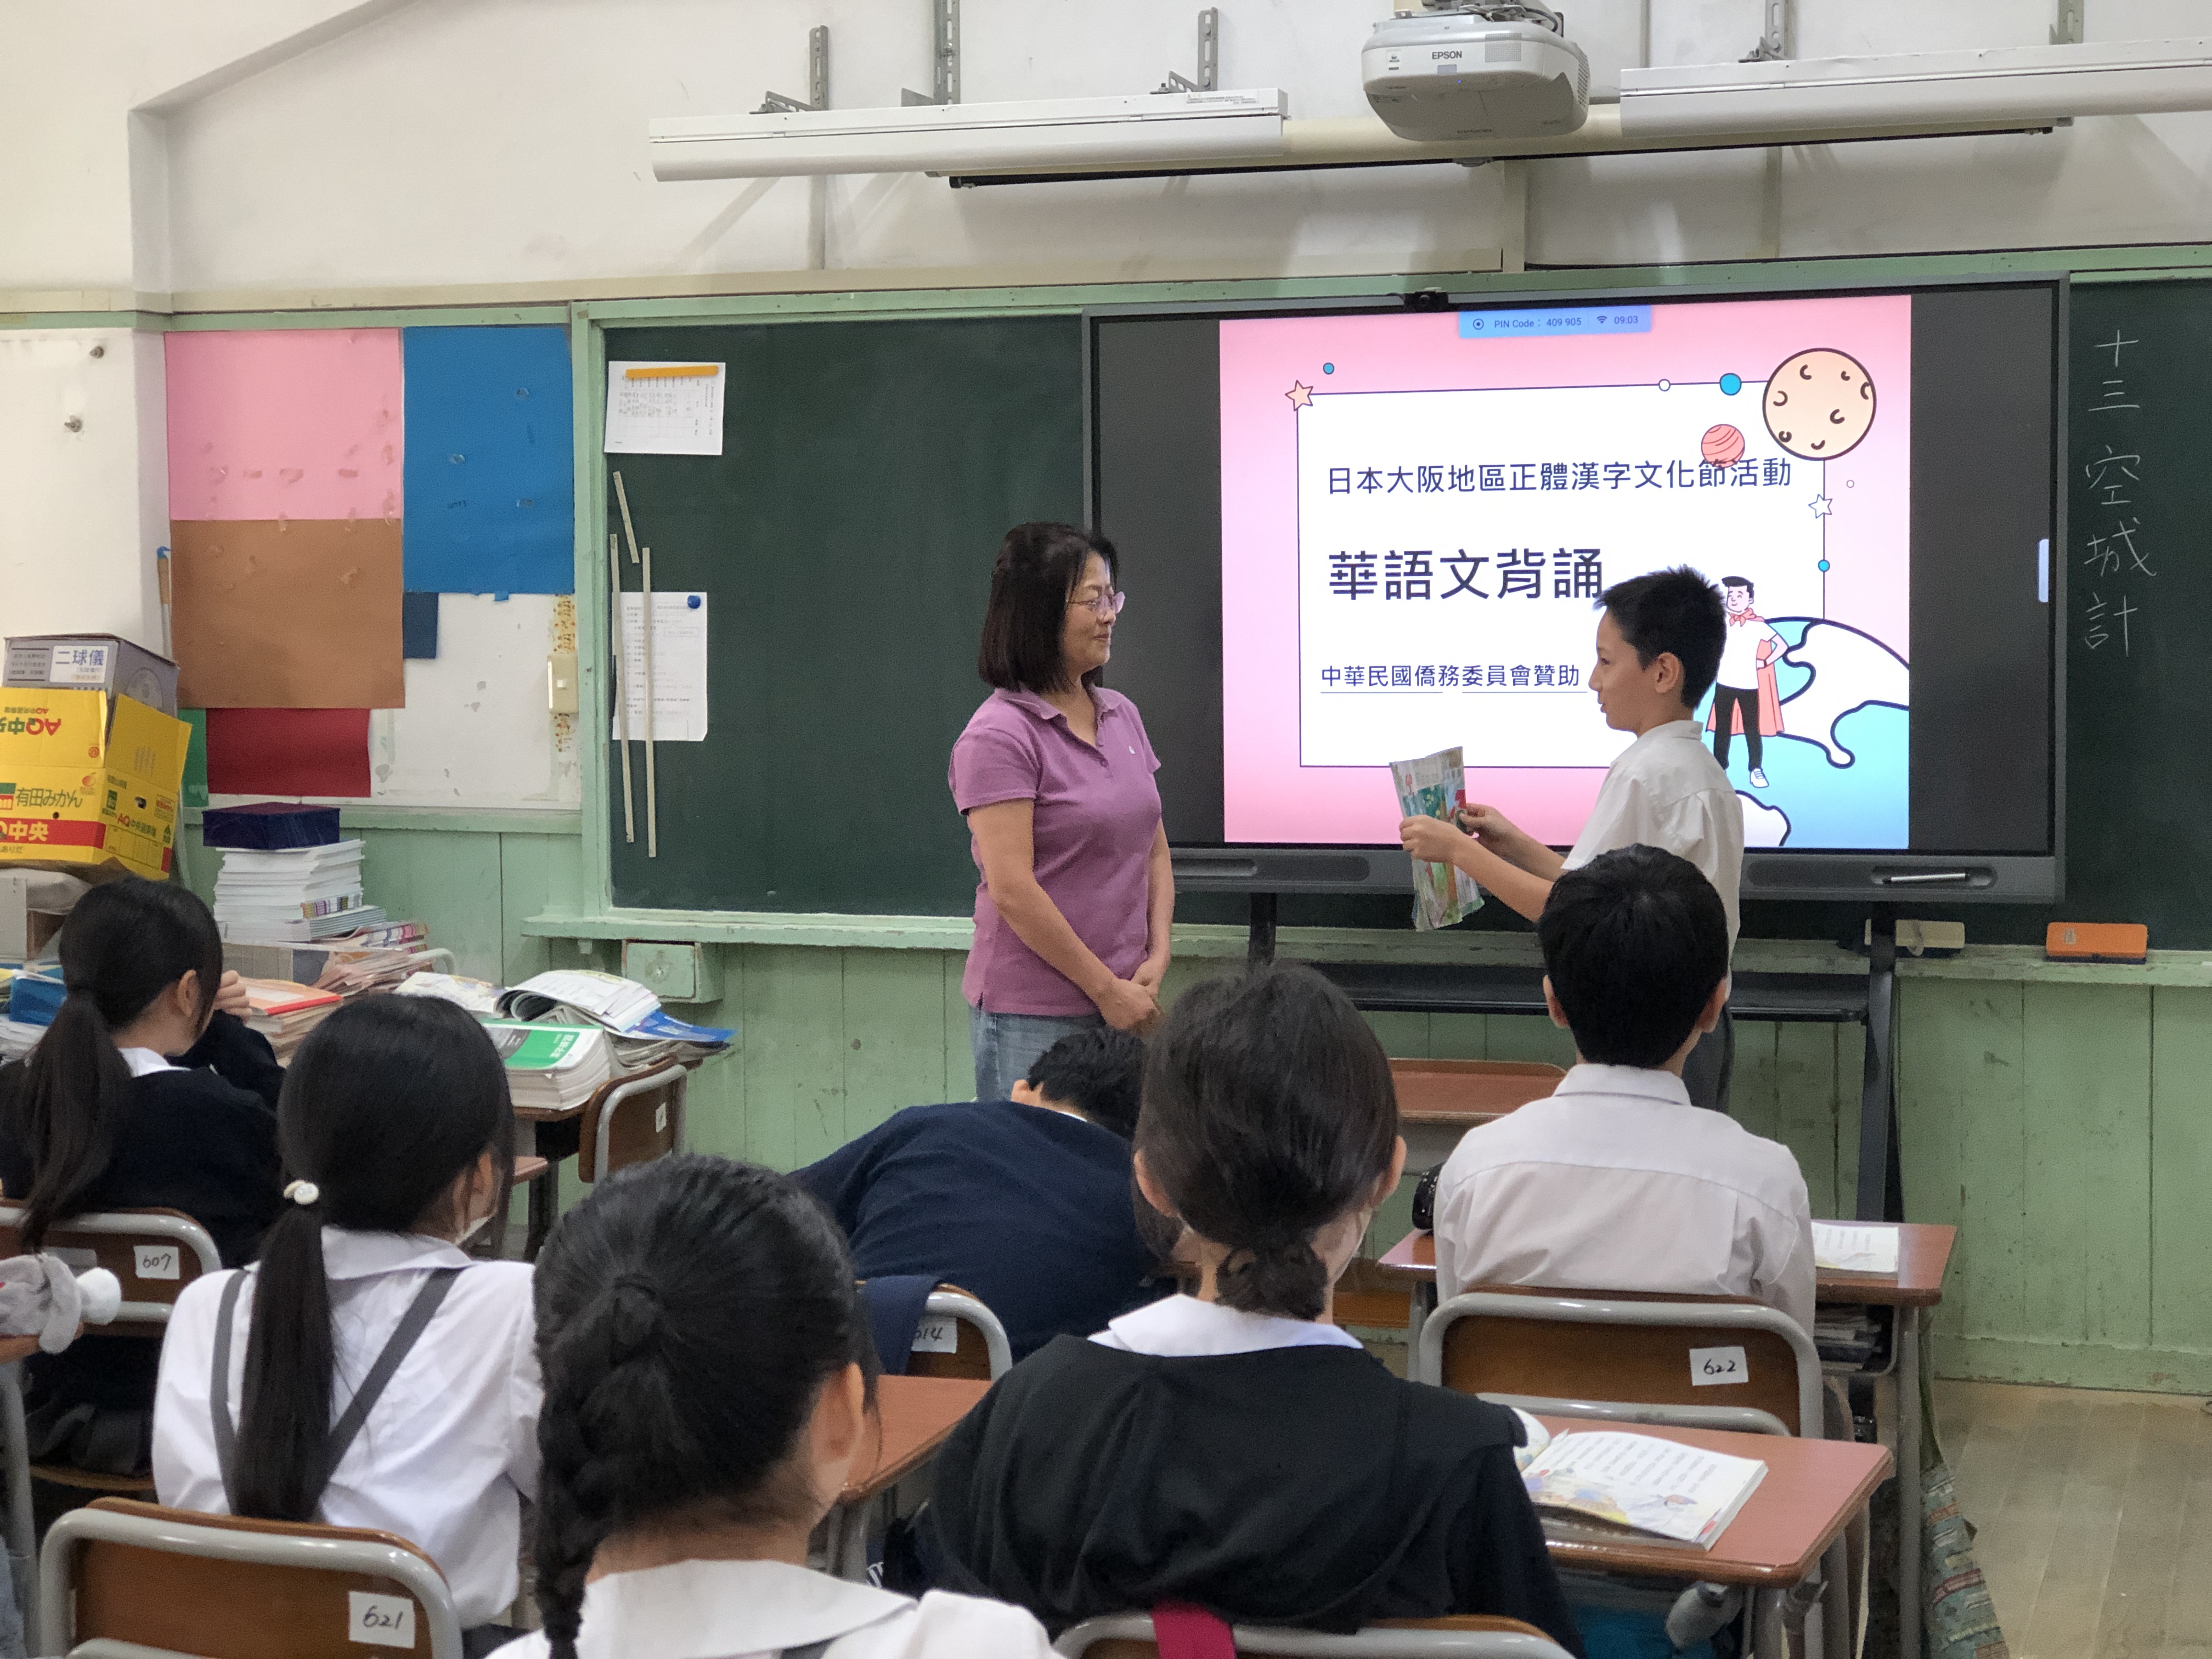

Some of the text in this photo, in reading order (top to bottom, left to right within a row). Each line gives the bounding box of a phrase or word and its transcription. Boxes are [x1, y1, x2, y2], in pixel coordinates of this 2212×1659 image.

[1432, 51, 1462, 59] EPSON
[1494, 320, 1509, 328] PIN
[1547, 318, 1562, 326] 409
[1565, 318, 1582, 326] 905
[1614, 316, 1638, 324] 09:03
[1329, 458, 1791, 495] 日本大阪地區正體漢字文化節活動
[2084, 445, 2156, 656] 空城計
[1329, 548, 1602, 600] 華語文背誦
[55, 650, 104, 666] 二球儀
[1321, 664, 1580, 687] 中華民國僑務委員會贊助
[15, 788, 83, 808] 有田みかん
[143, 1253, 171, 1271] 607
[1703, 1358, 1736, 1375] 622
[363, 1605, 403, 1629] 621
